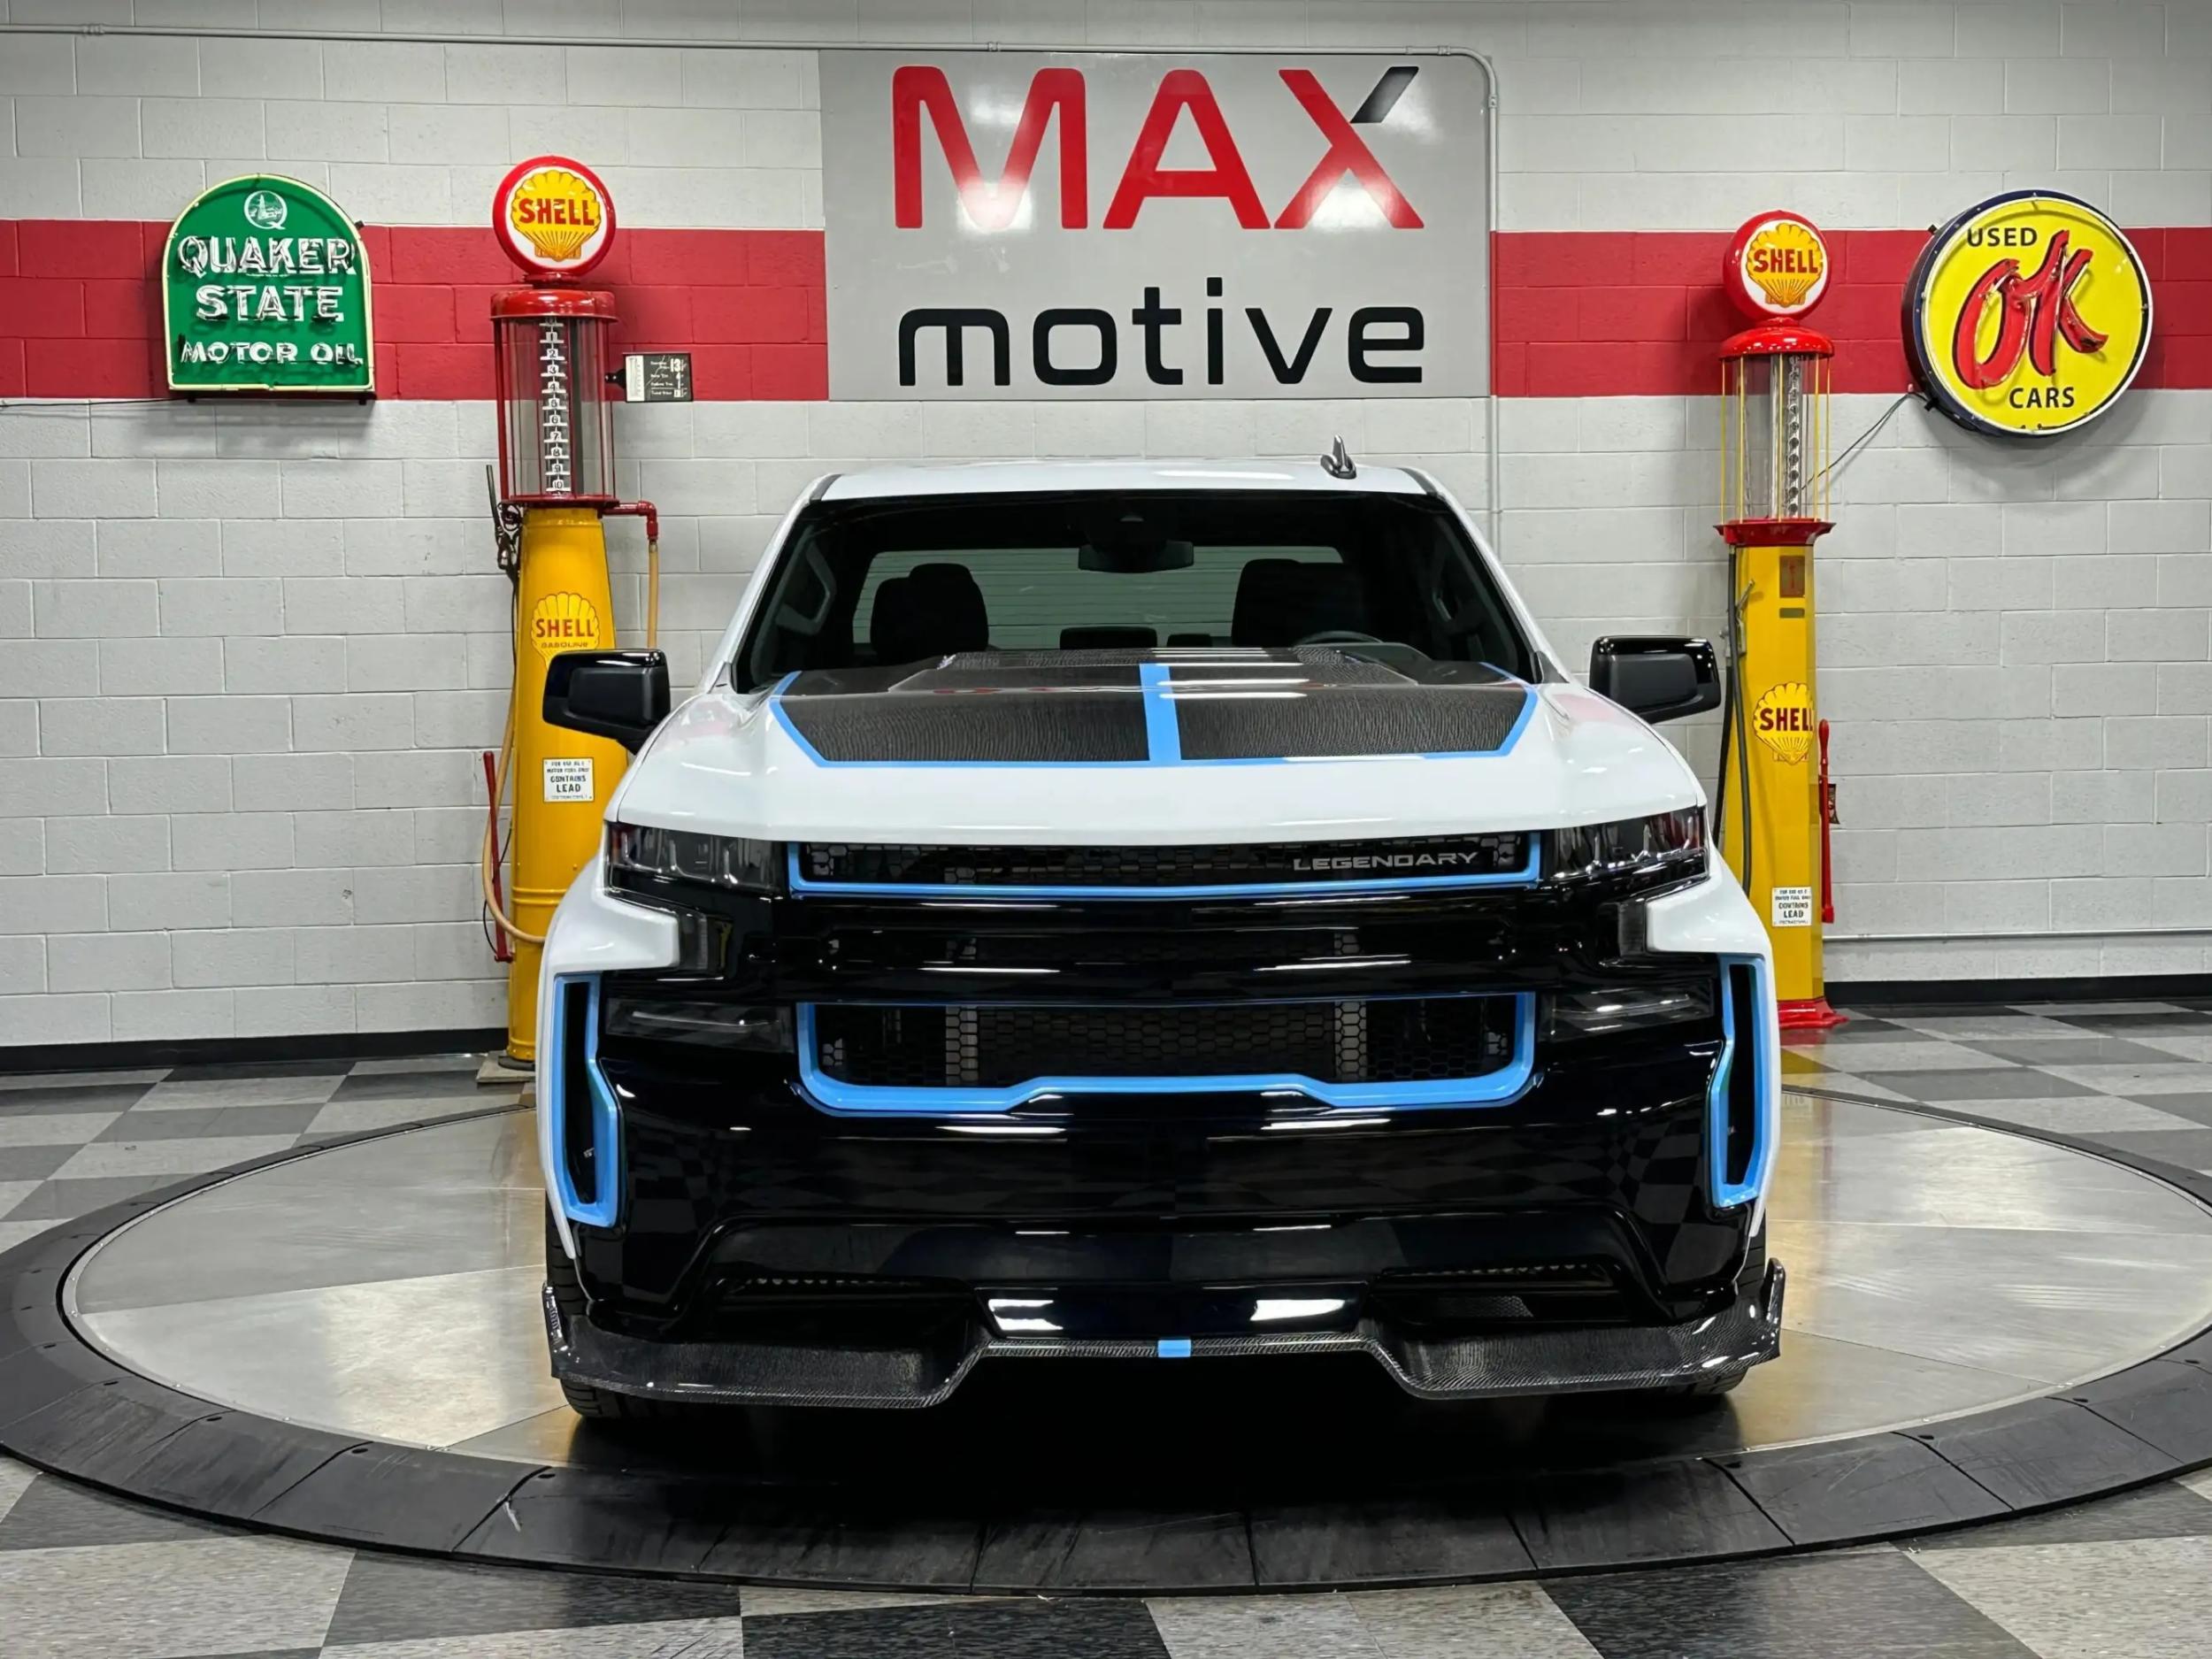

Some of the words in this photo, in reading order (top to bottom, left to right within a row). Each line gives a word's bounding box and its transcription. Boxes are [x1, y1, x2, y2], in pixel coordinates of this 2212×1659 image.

[893, 66, 1425, 229] MAX
[518, 198, 595, 226] SHELL
[1967, 227, 2038, 248] USED
[178, 236, 357, 278] QUAKER
[1754, 249, 1818, 273] SHELL
[196, 285, 345, 322] STATE
[1952, 230, 2109, 390] OK
[898, 277, 1425, 386] motive
[180, 342, 298, 365] MOTOR
[311, 342, 364, 365] OIL
[2009, 387, 2075, 409] CARS
[535, 618, 595, 638] SHELL
[557, 783, 581, 793] LEAD
[1294, 852, 1479, 872] LEGENDARY
[1784, 910, 1804, 918] LEAD
